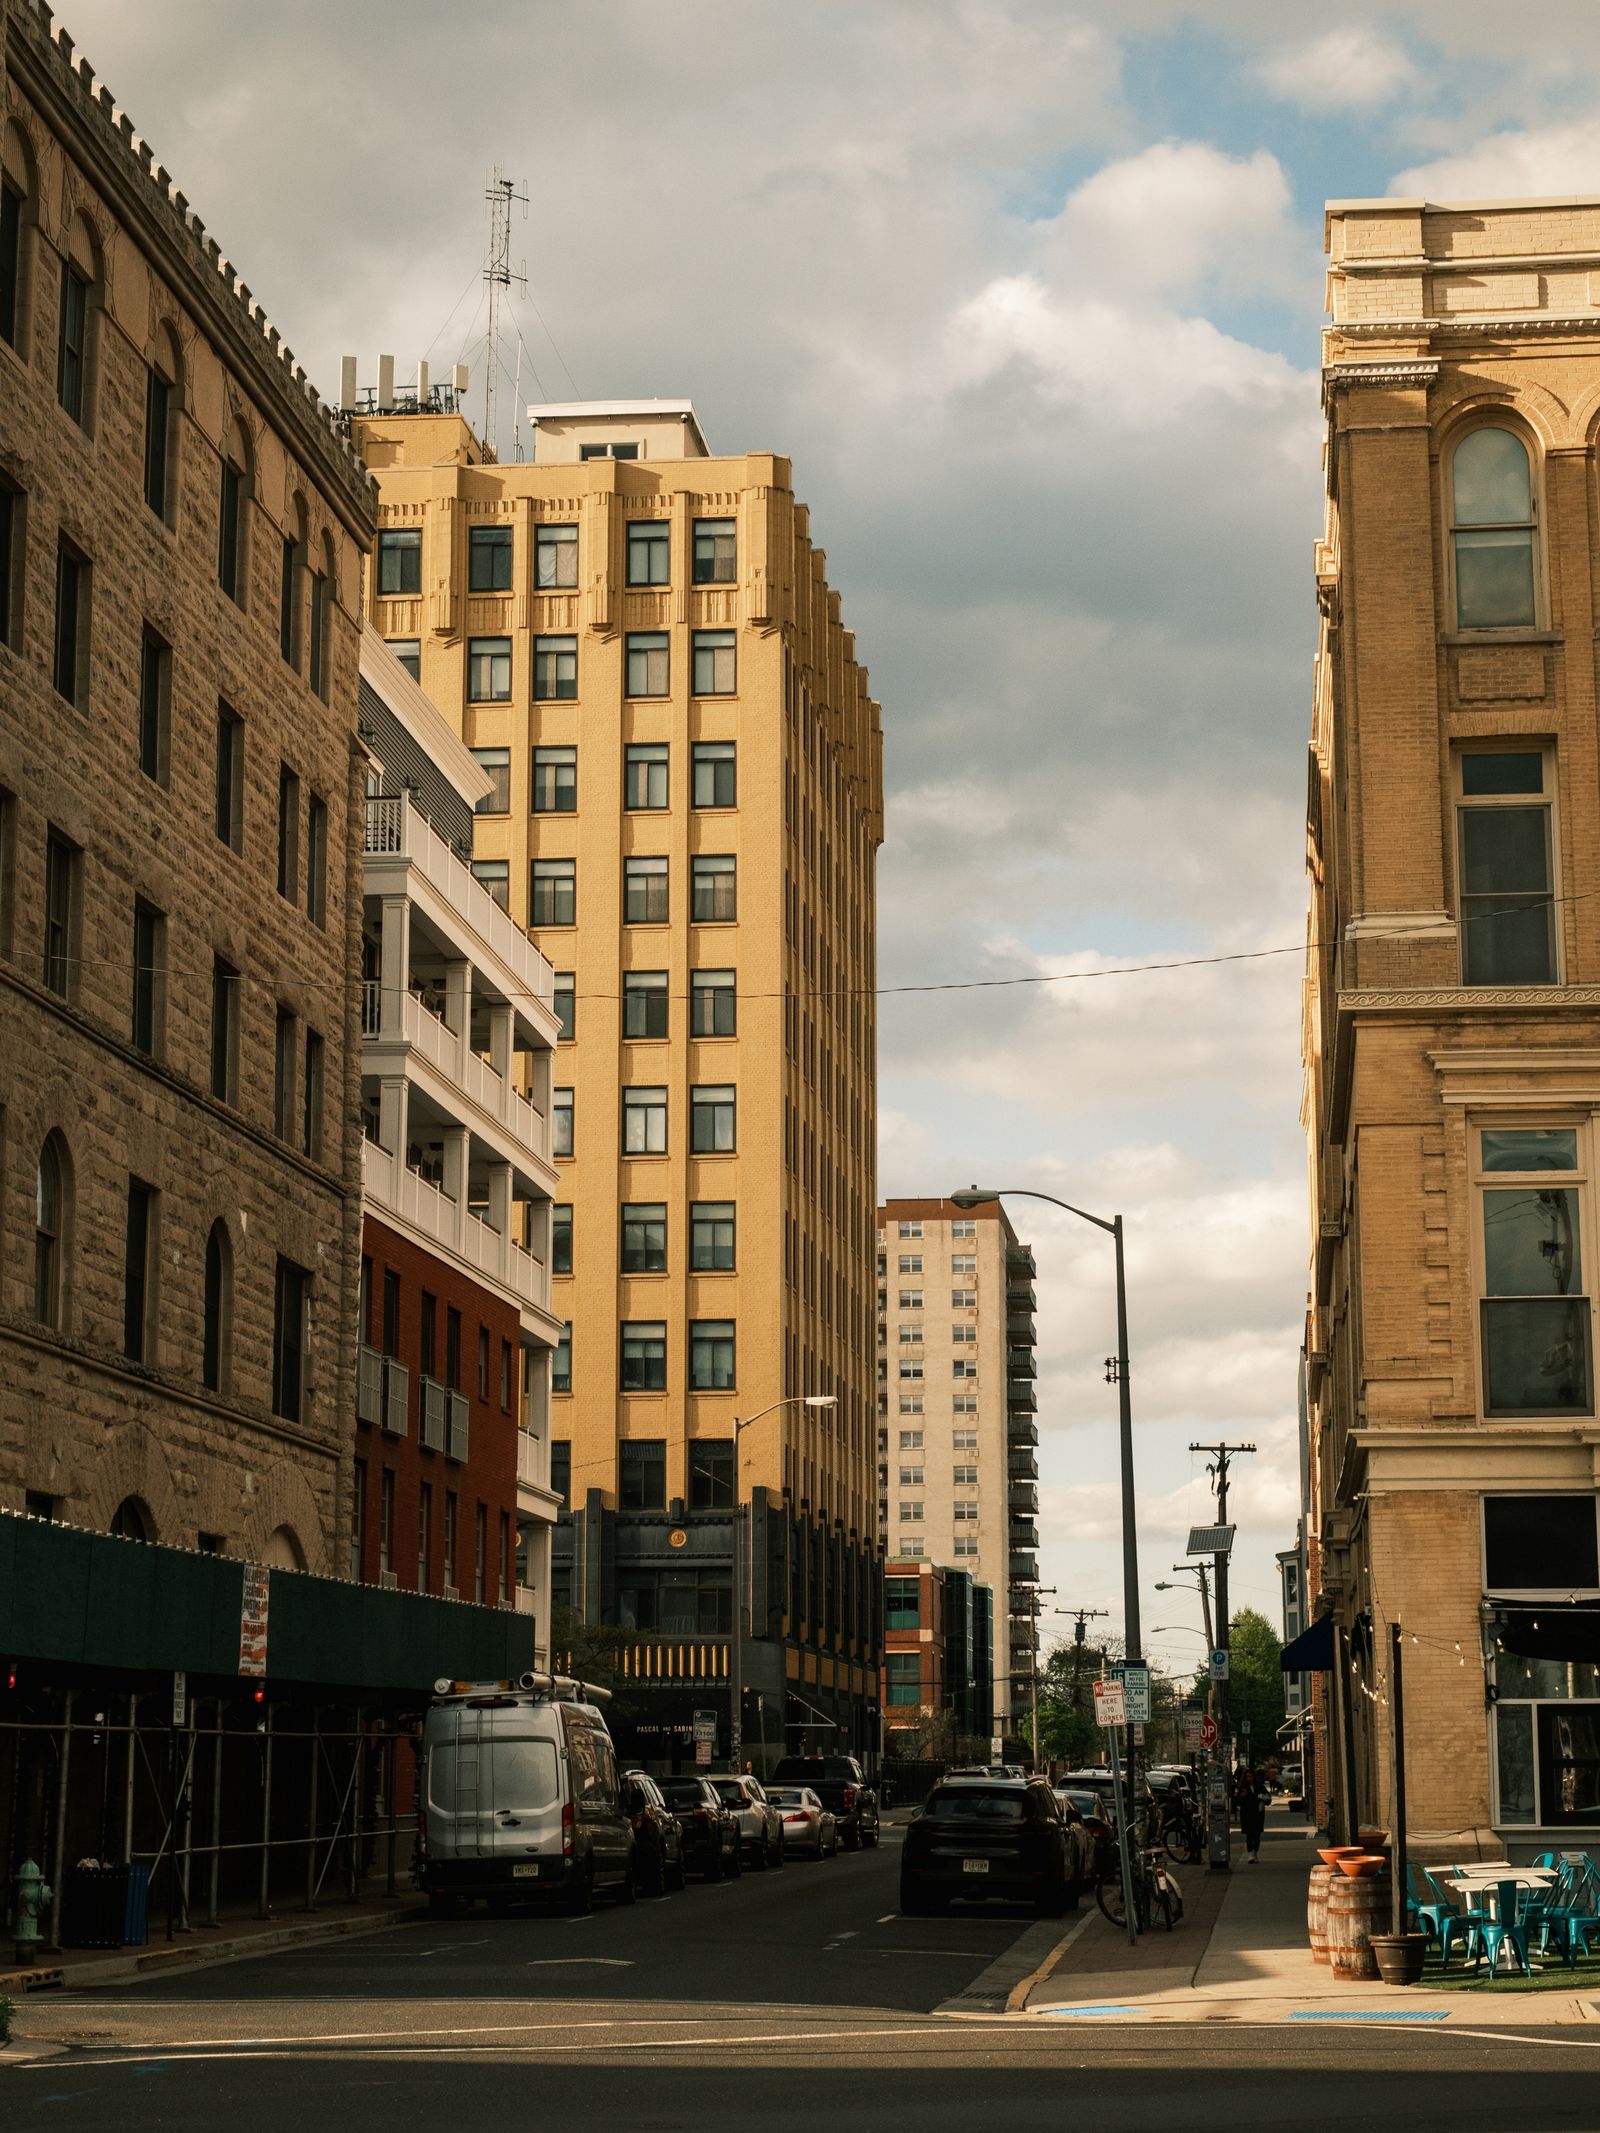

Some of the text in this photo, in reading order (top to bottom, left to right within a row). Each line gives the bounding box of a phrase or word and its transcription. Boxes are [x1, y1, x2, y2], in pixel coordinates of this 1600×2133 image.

[1095, 1684, 1103, 1694] NO
[1102, 1697, 1117, 1705] HERE
[1100, 1714, 1124, 1722] CORNER
[636, 1725, 659, 1733] PASCAL
[1200, 1725, 1215, 1738] OP
